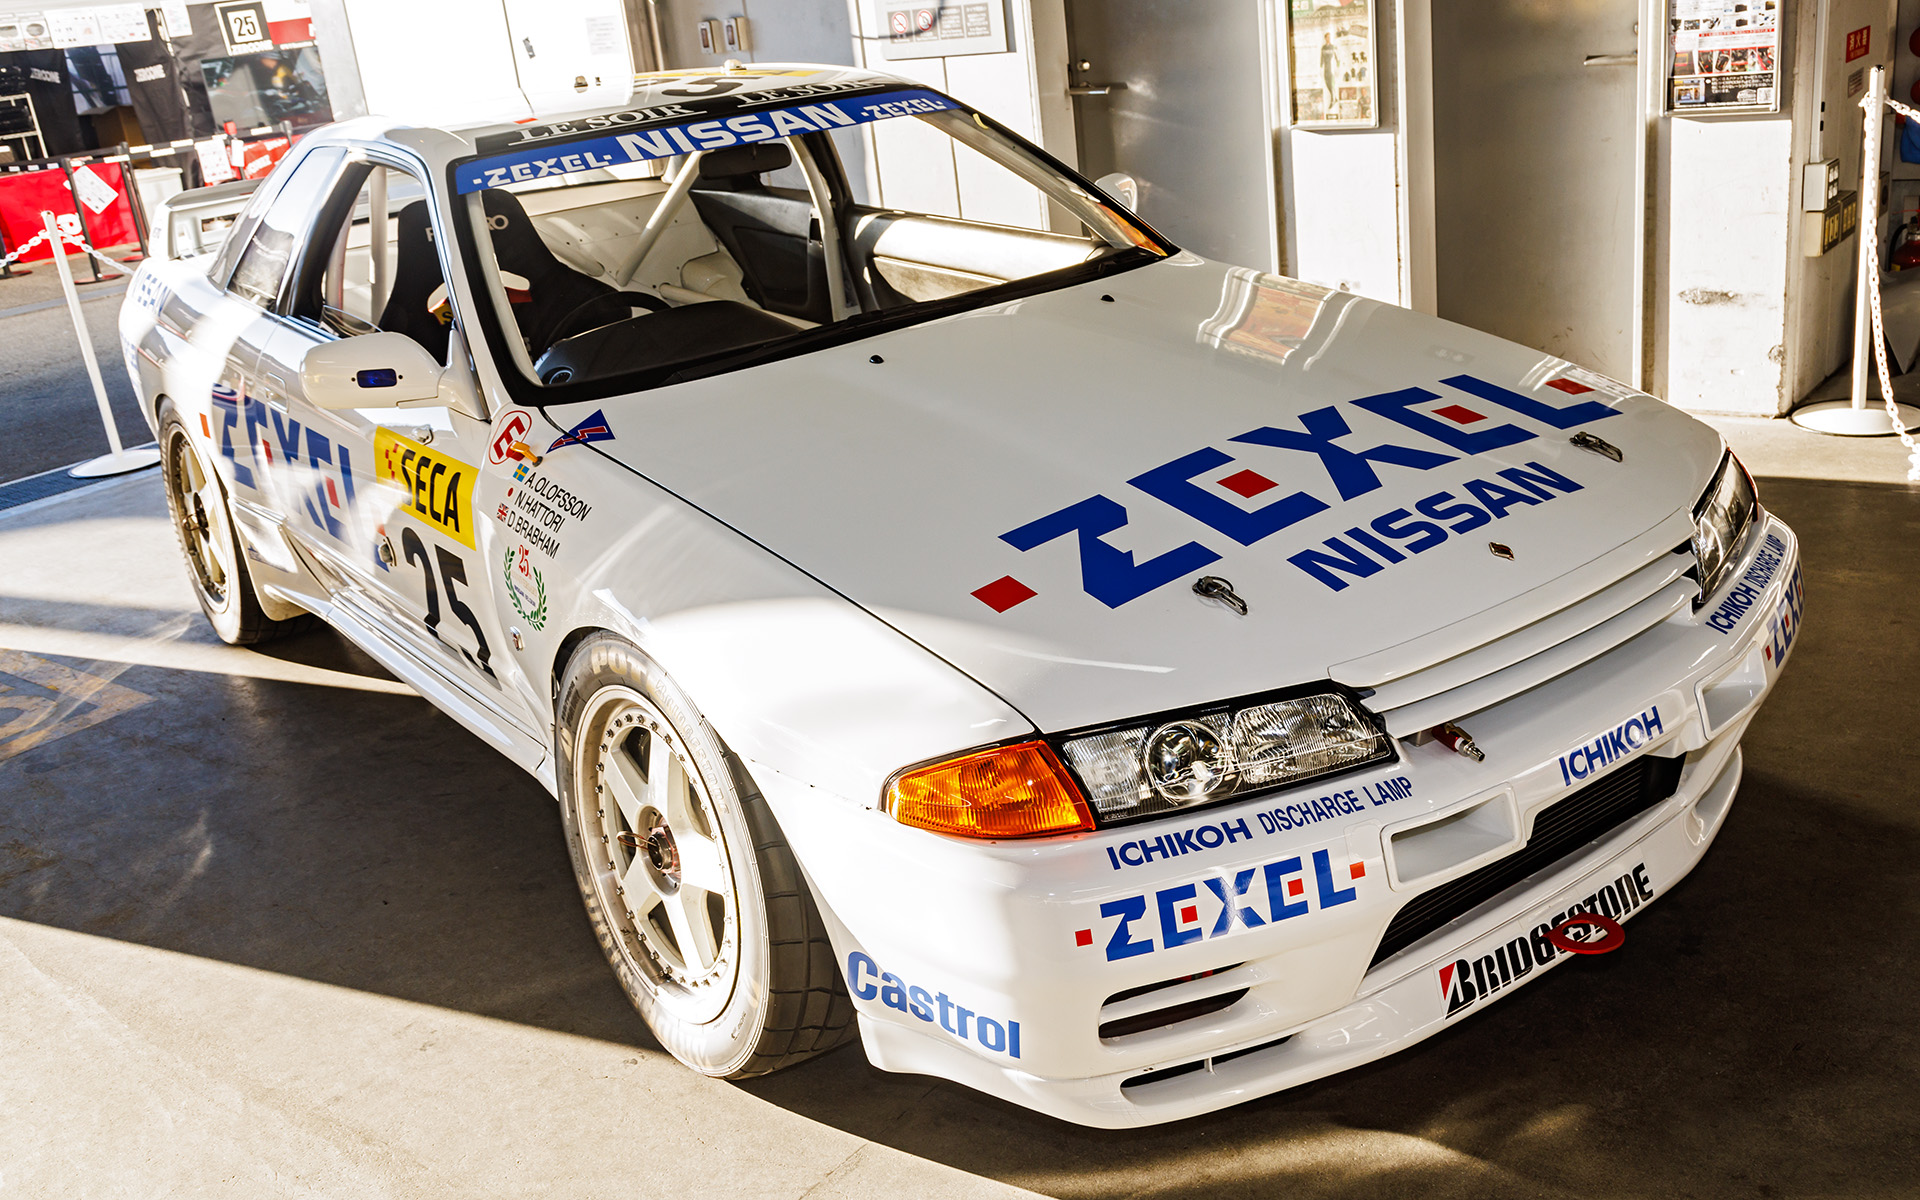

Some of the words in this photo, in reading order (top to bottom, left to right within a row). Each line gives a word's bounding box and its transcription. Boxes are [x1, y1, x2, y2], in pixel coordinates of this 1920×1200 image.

[233, 15, 256, 37] 25
[516, 121, 578, 142] LE
[588, 103, 695, 130] SOIR
[615, 103, 857, 163] NISSAN
[736, 87, 788, 104] LE
[863, 97, 942, 120] ZEXEL
[484, 152, 607, 187] ZEXEL
[212, 383, 391, 573] ZEXEL
[400, 448, 462, 534] SECA
[515, 489, 566, 534] N.HATTORI
[524, 470, 593, 523] A.OLOFSSON
[998, 374, 1624, 610] ZEXEL
[506, 510, 561, 560] D.BRABHAM
[1286, 461, 1585, 592] NISSAN
[402, 526, 501, 682] 25
[1705, 582, 1761, 635] ICHIKOH
[1743, 549, 1781, 589] DISCHARGE
[1558, 705, 1664, 787] ICHIKOH
[1106, 819, 1253, 871] ICHIKOH
[1261, 790, 1365, 835] DISCHARGE
[1371, 776, 1413, 806] LAMP
[1100, 849, 1357, 962] ZEXEL
[846, 951, 1021, 1060] Castrol
